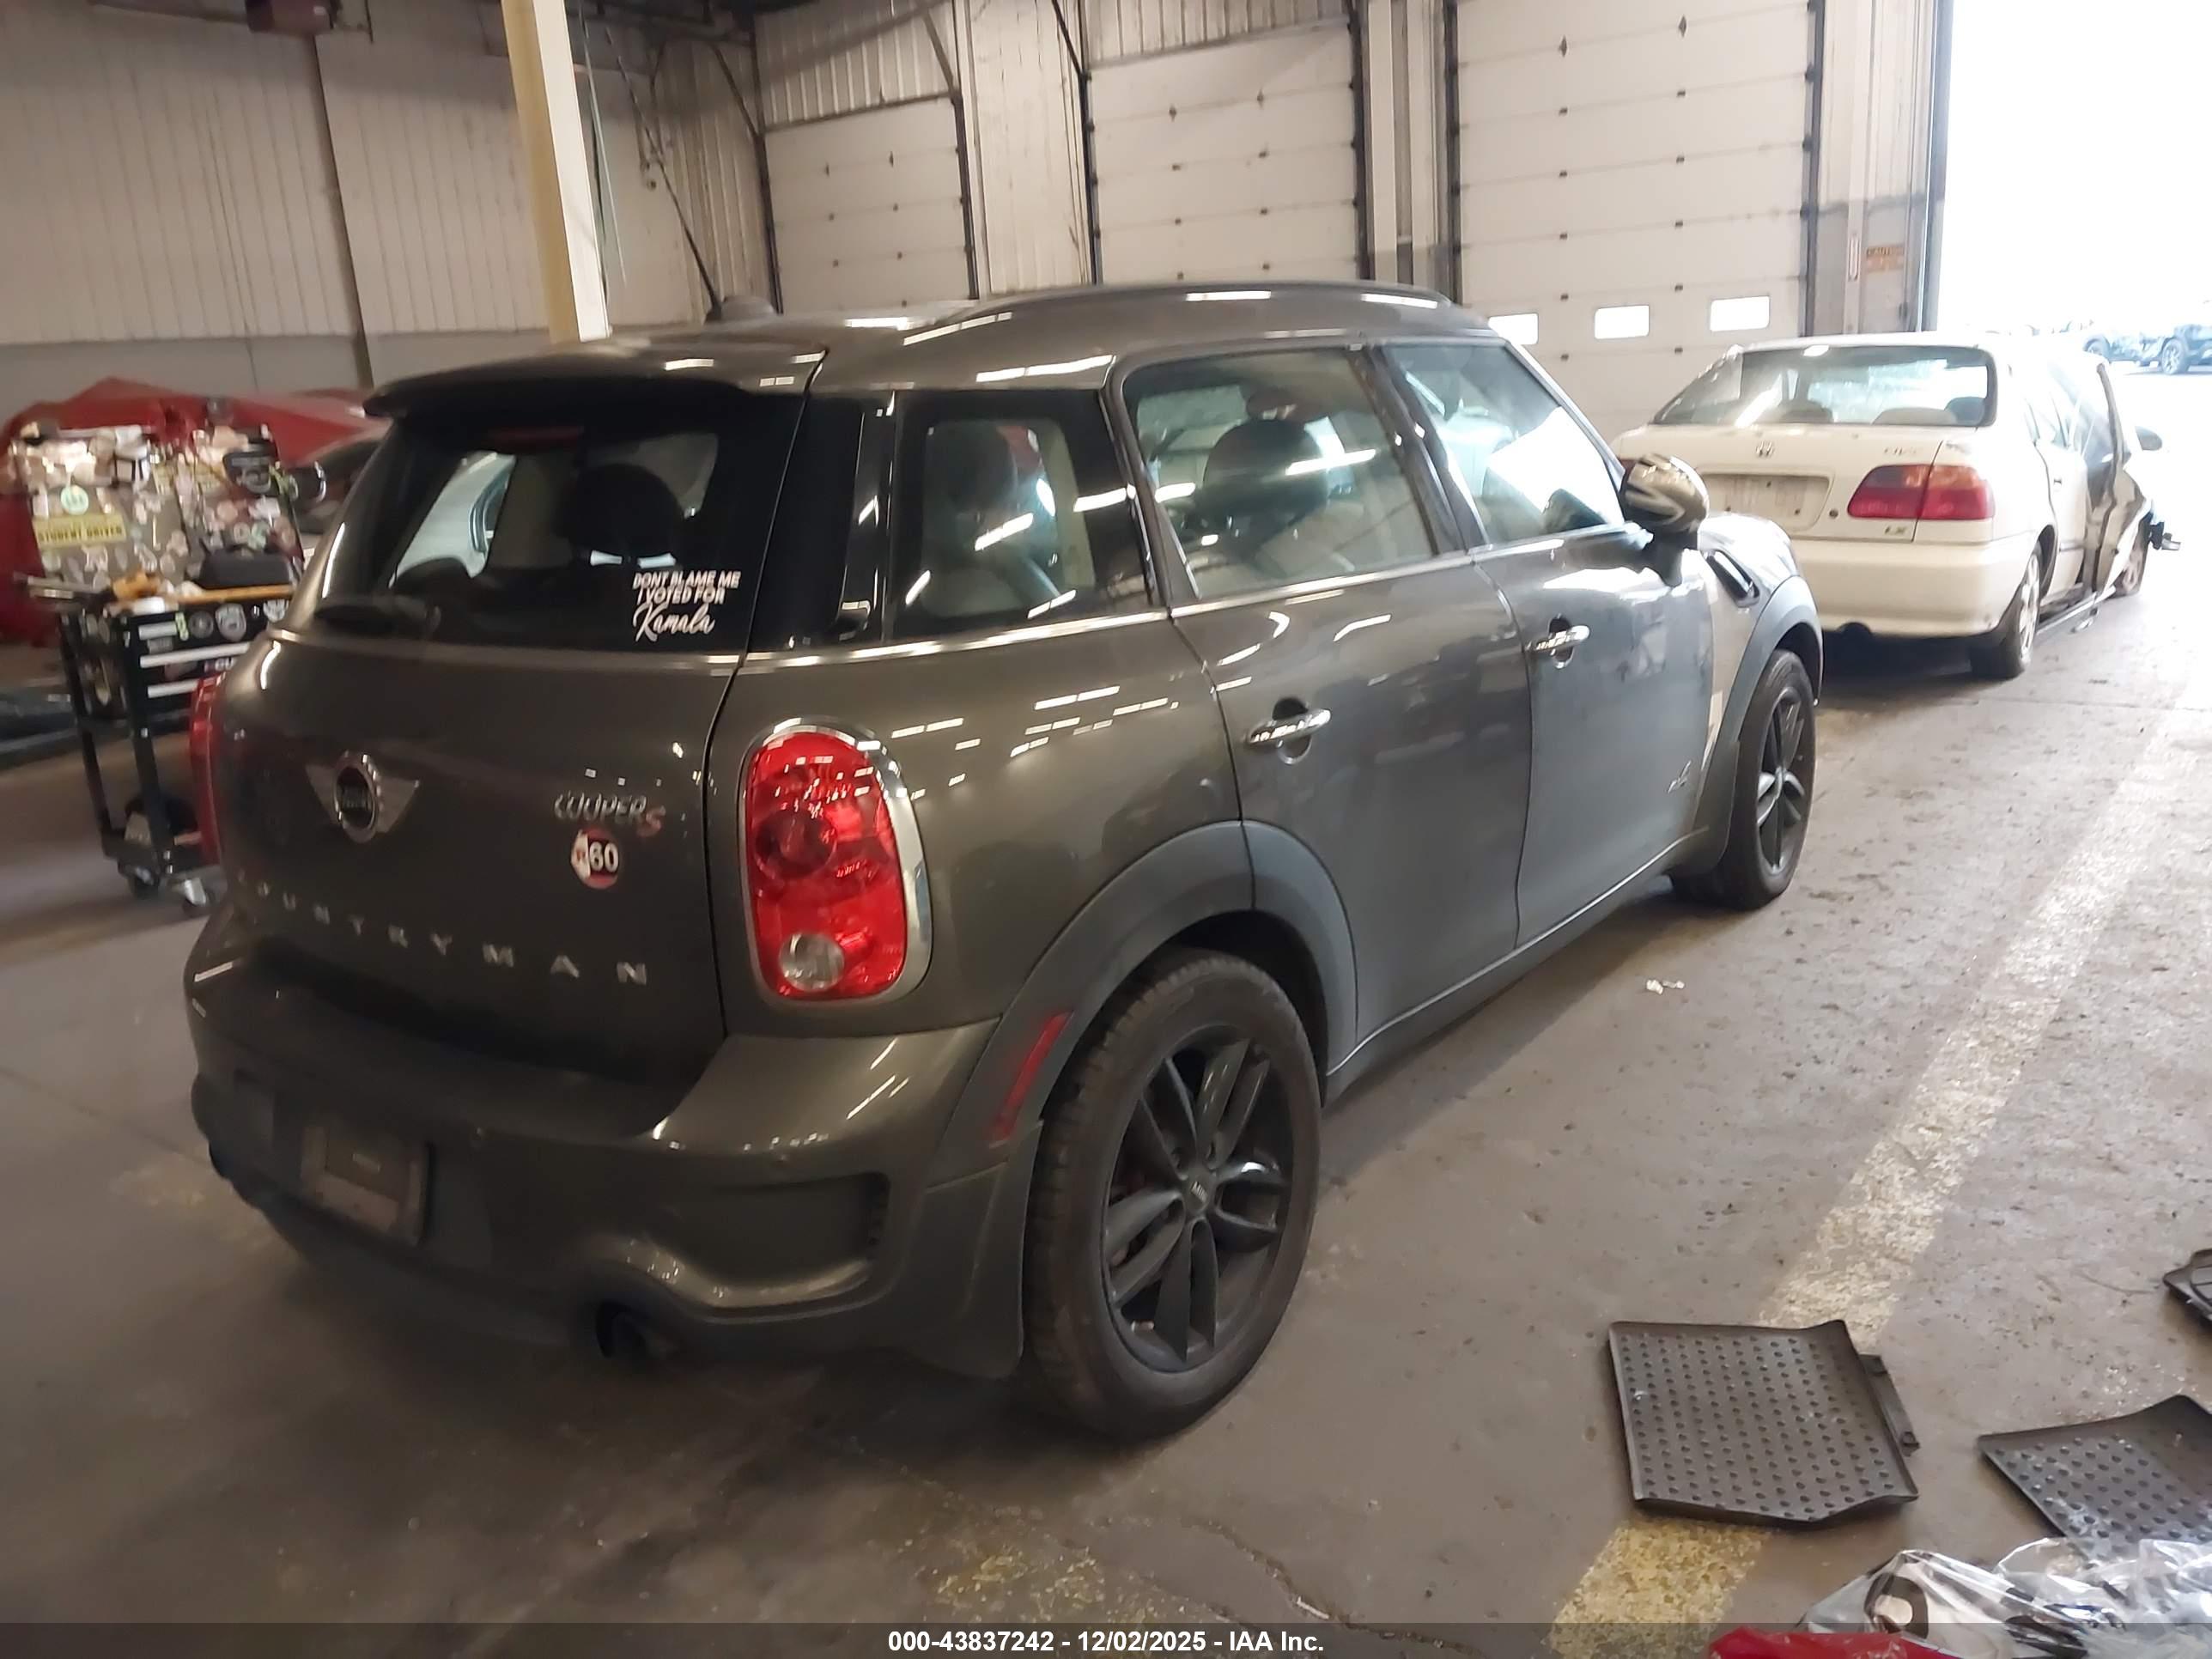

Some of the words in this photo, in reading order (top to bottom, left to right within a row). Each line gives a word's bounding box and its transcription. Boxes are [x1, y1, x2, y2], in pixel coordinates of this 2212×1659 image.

[670, 570, 716, 588] BLAME
[718, 570, 741, 588] ME
[646, 586, 693, 605] VOTED
[694, 586, 726, 605] FOR
[633, 600, 715, 642] Kamala
[553, 791, 647, 823] COOPER
